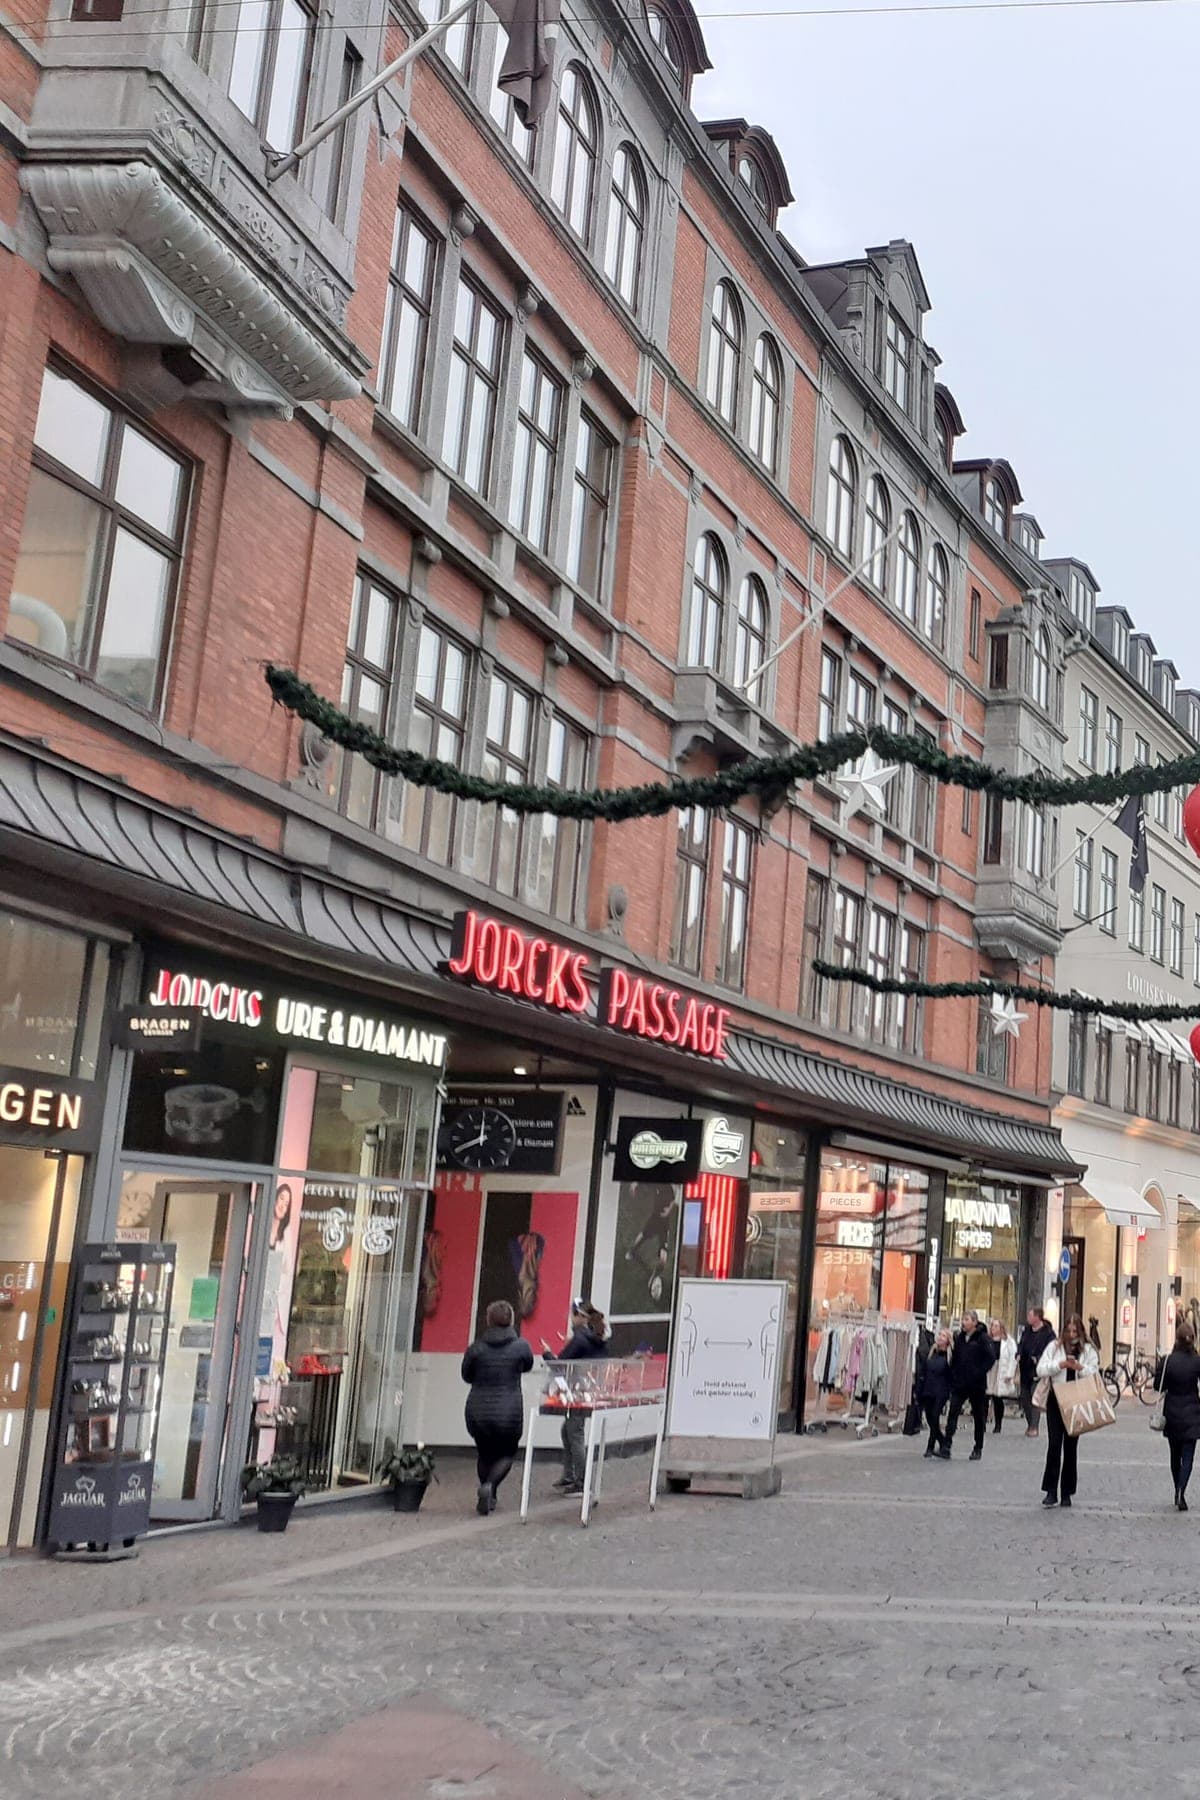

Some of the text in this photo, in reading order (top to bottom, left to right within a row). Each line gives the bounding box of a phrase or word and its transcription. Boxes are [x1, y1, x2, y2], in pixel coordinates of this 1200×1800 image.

[449, 911, 732, 1060] JORCKS PASSAGE
[130, 1018, 190, 1030] SKAGEN
[276, 998, 327, 1041] URE
[328, 1010, 344, 1045] &
[347, 1015, 447, 1067] DIAMANT
[0, 1083, 82, 1130] GEN
[829, 1197, 862, 1206] PIECES
[61, 1491, 105, 1508] JAGUAR
